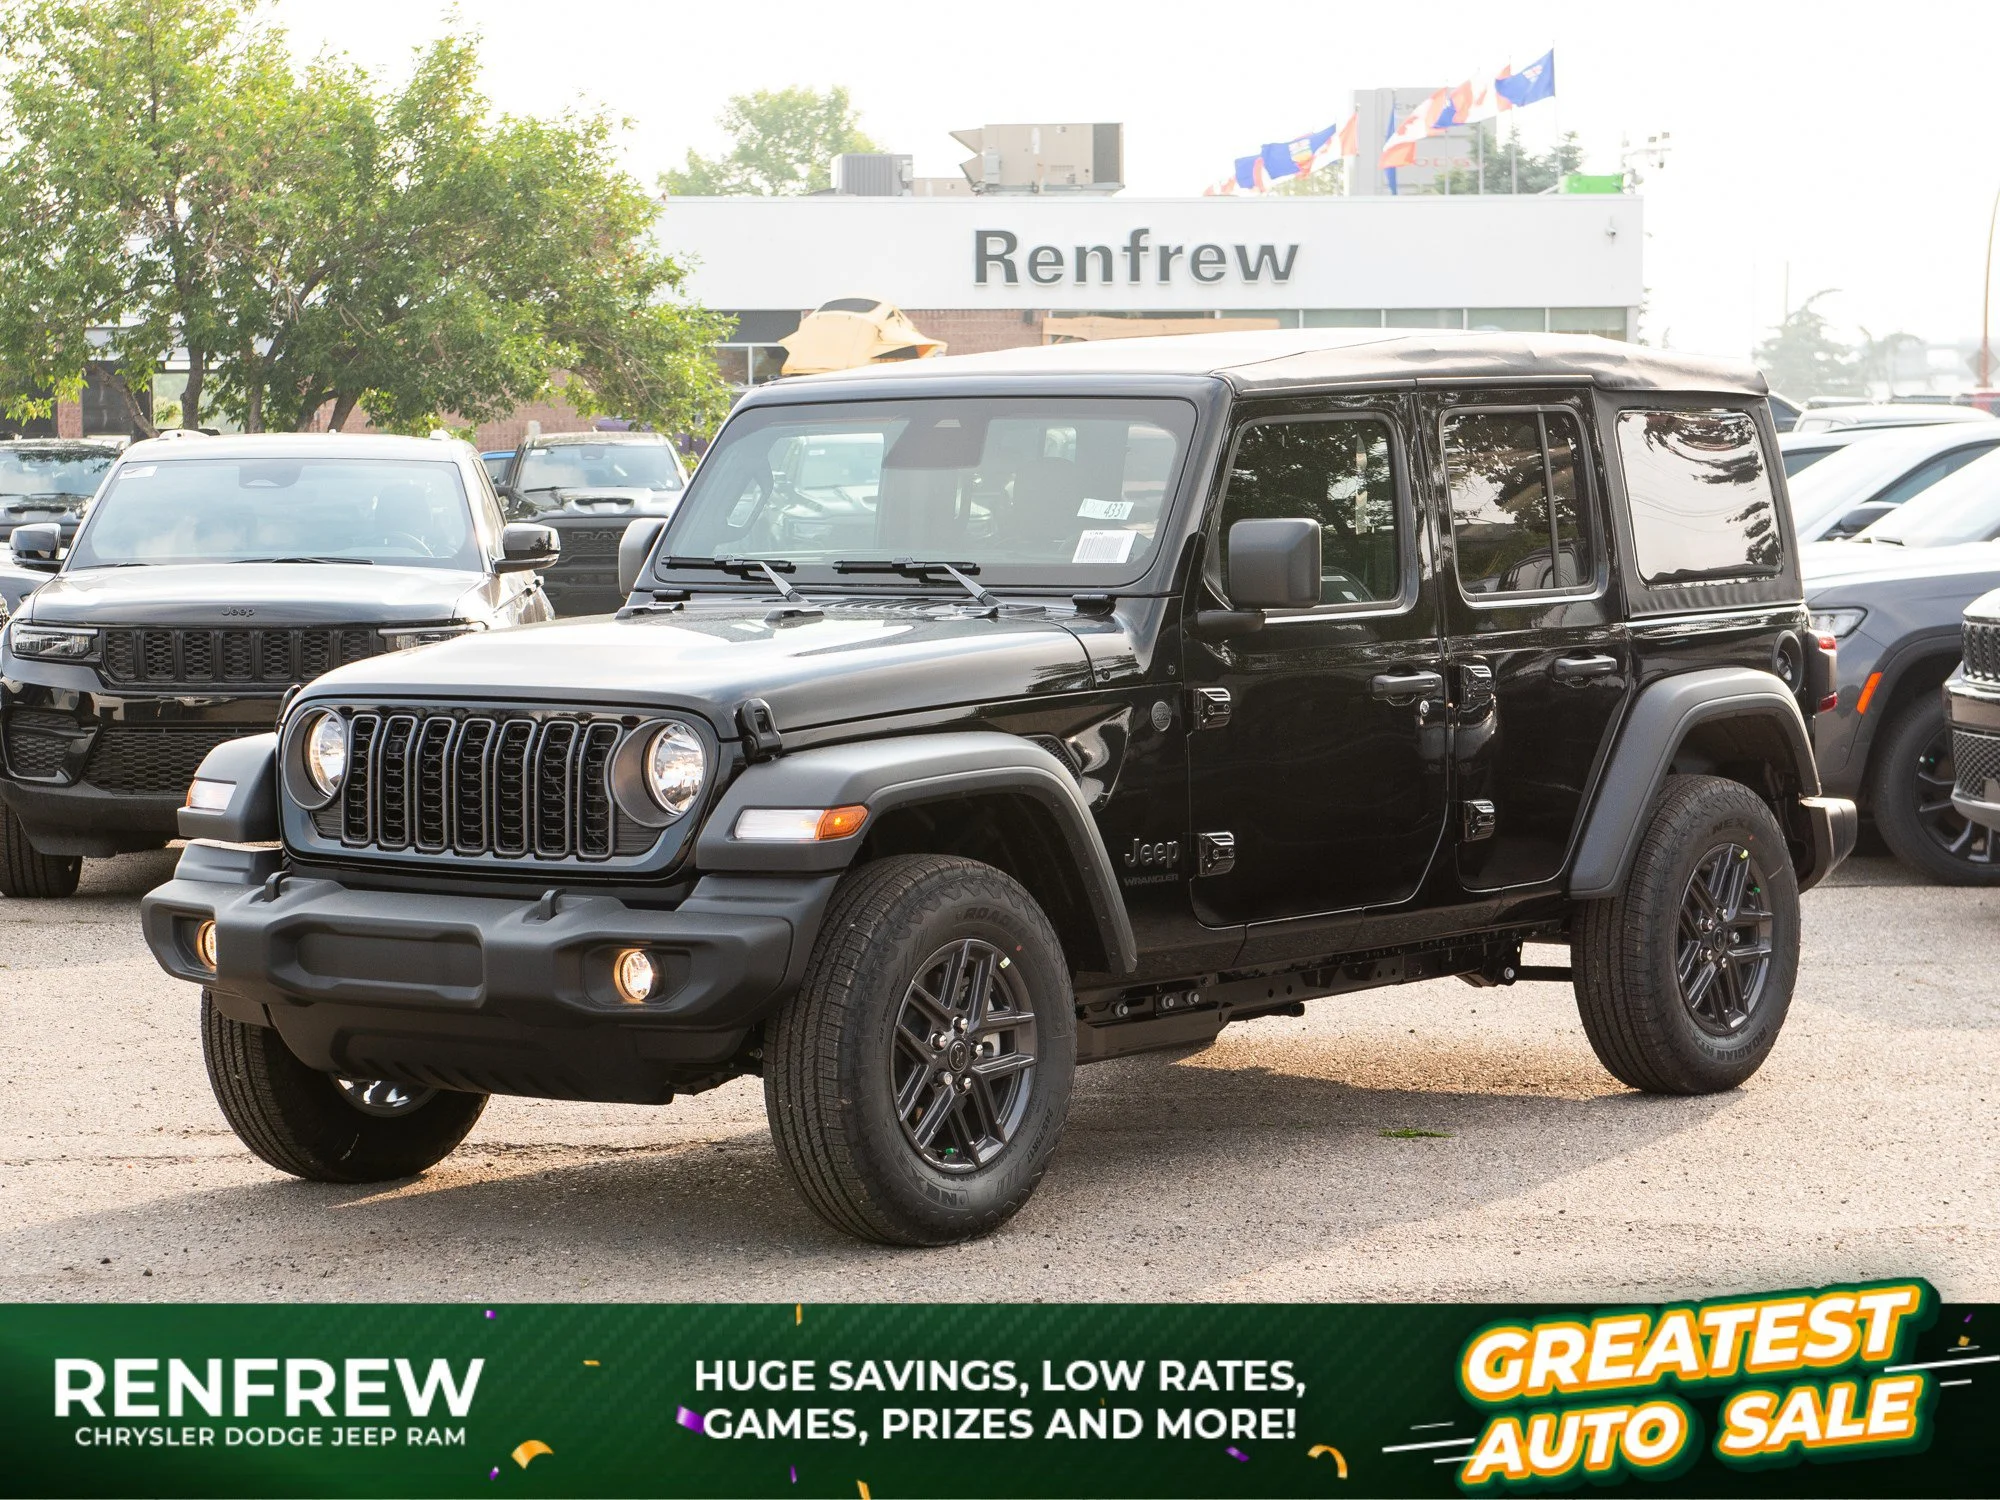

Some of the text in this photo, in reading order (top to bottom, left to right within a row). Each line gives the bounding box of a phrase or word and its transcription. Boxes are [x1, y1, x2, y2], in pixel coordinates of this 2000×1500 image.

[975, 229, 1299, 285] Renfrew
[221, 603, 255, 617] Jeep
[1124, 838, 1181, 869] Jeep
[1124, 873, 1179, 886] WRANGLER
